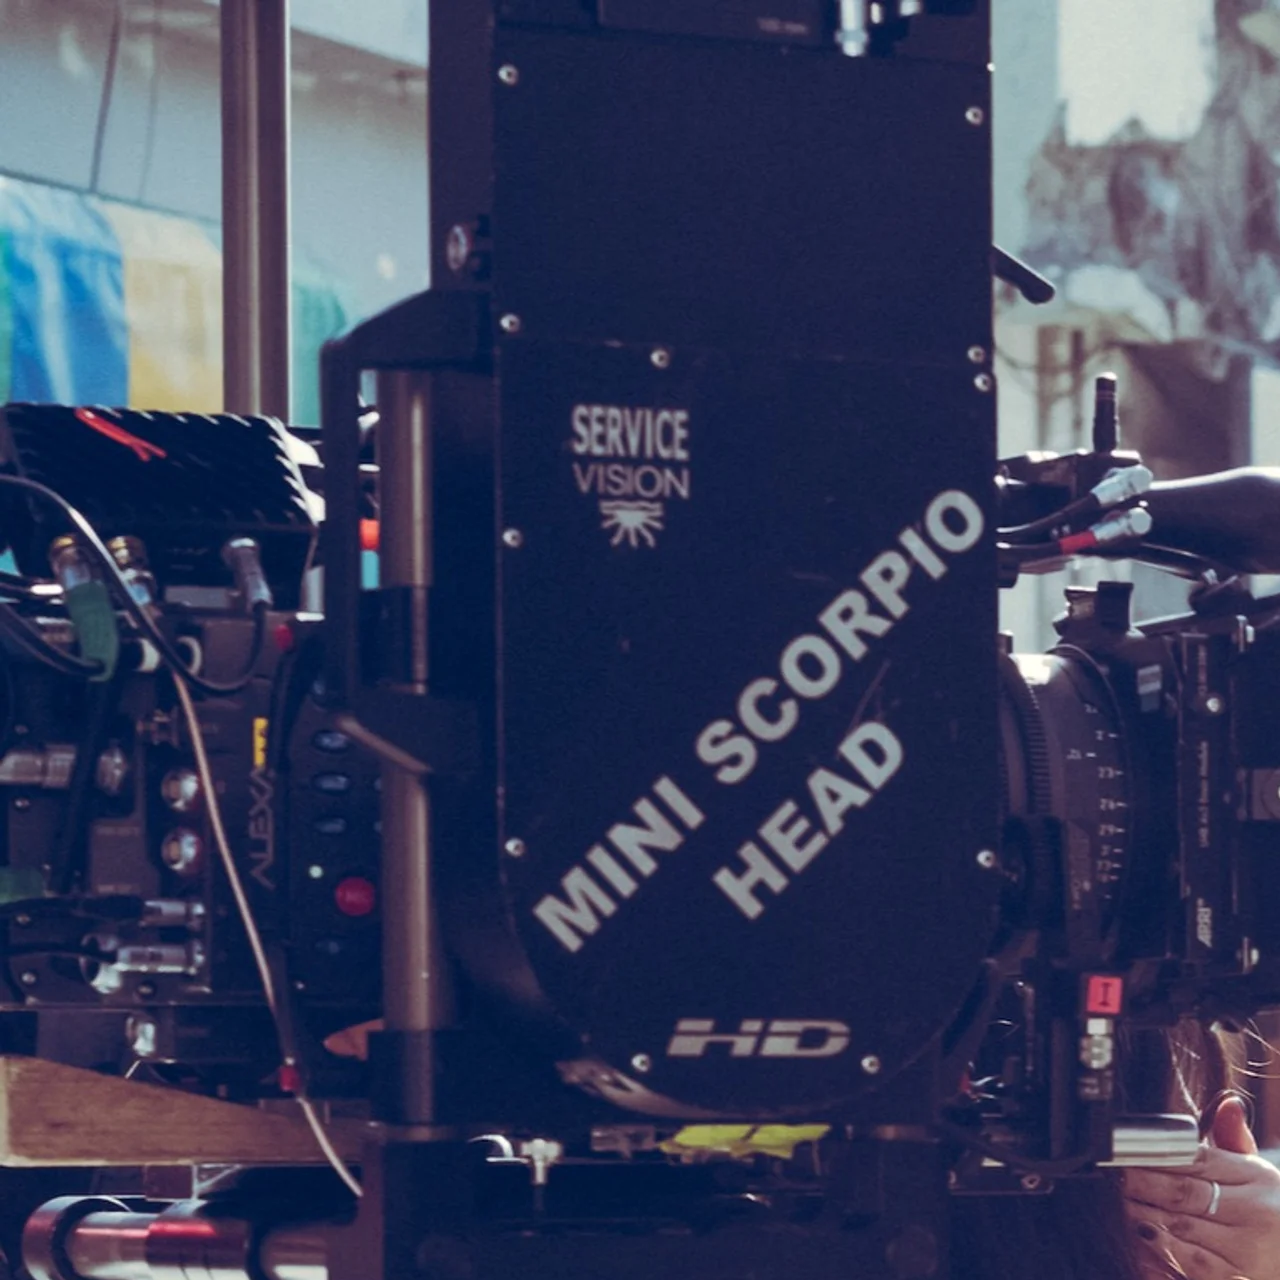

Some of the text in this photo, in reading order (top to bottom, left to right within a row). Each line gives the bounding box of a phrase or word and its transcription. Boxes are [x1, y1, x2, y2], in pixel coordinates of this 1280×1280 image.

[572, 403, 690, 460] SERVICE
[572, 461, 690, 498] VISION
[533, 490, 985, 952] MINI SCORPIO
[249, 766, 275, 890] ALEXA
[713, 722, 903, 919] HEAD
[667, 1019, 850, 1057] HD
